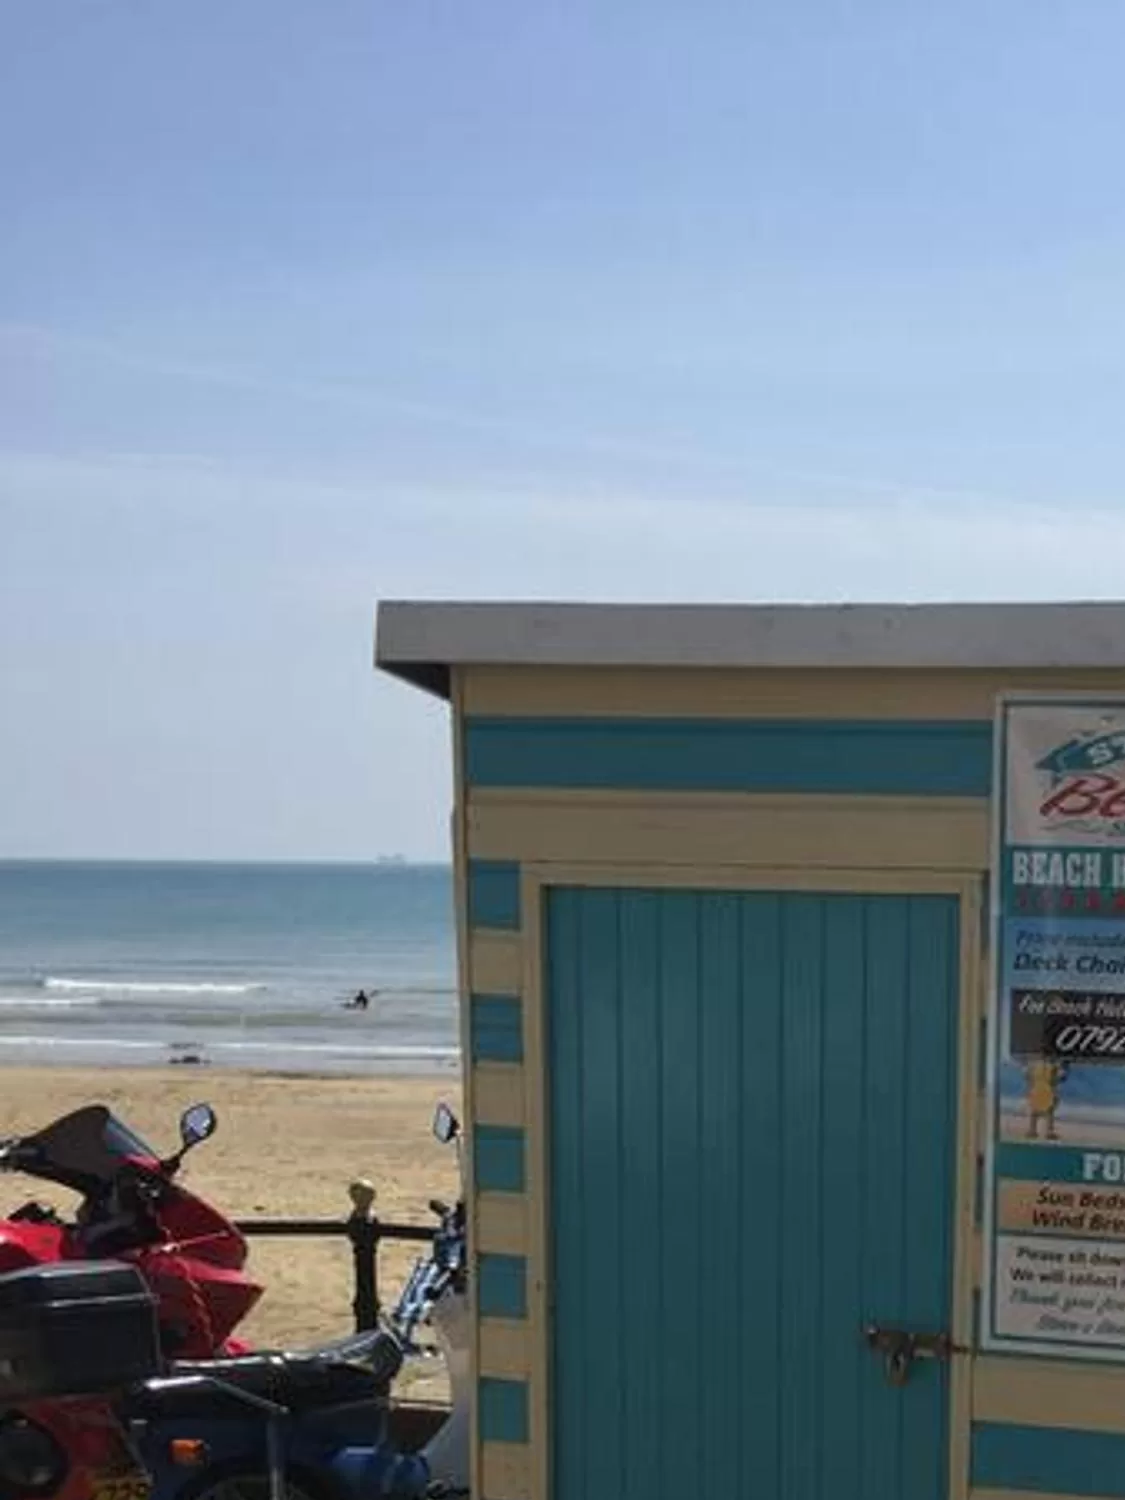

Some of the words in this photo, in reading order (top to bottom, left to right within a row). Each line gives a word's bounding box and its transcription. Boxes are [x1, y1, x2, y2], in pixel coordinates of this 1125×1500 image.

[1013, 851, 1101, 886] BEACH
[1013, 953, 1067, 972] Deck
[1037, 1187, 1074, 1206] Sun
[1033, 1210, 1083, 1230] Wind
[1011, 1267, 1034, 1282] We
[1040, 1269, 1063, 1284] will
